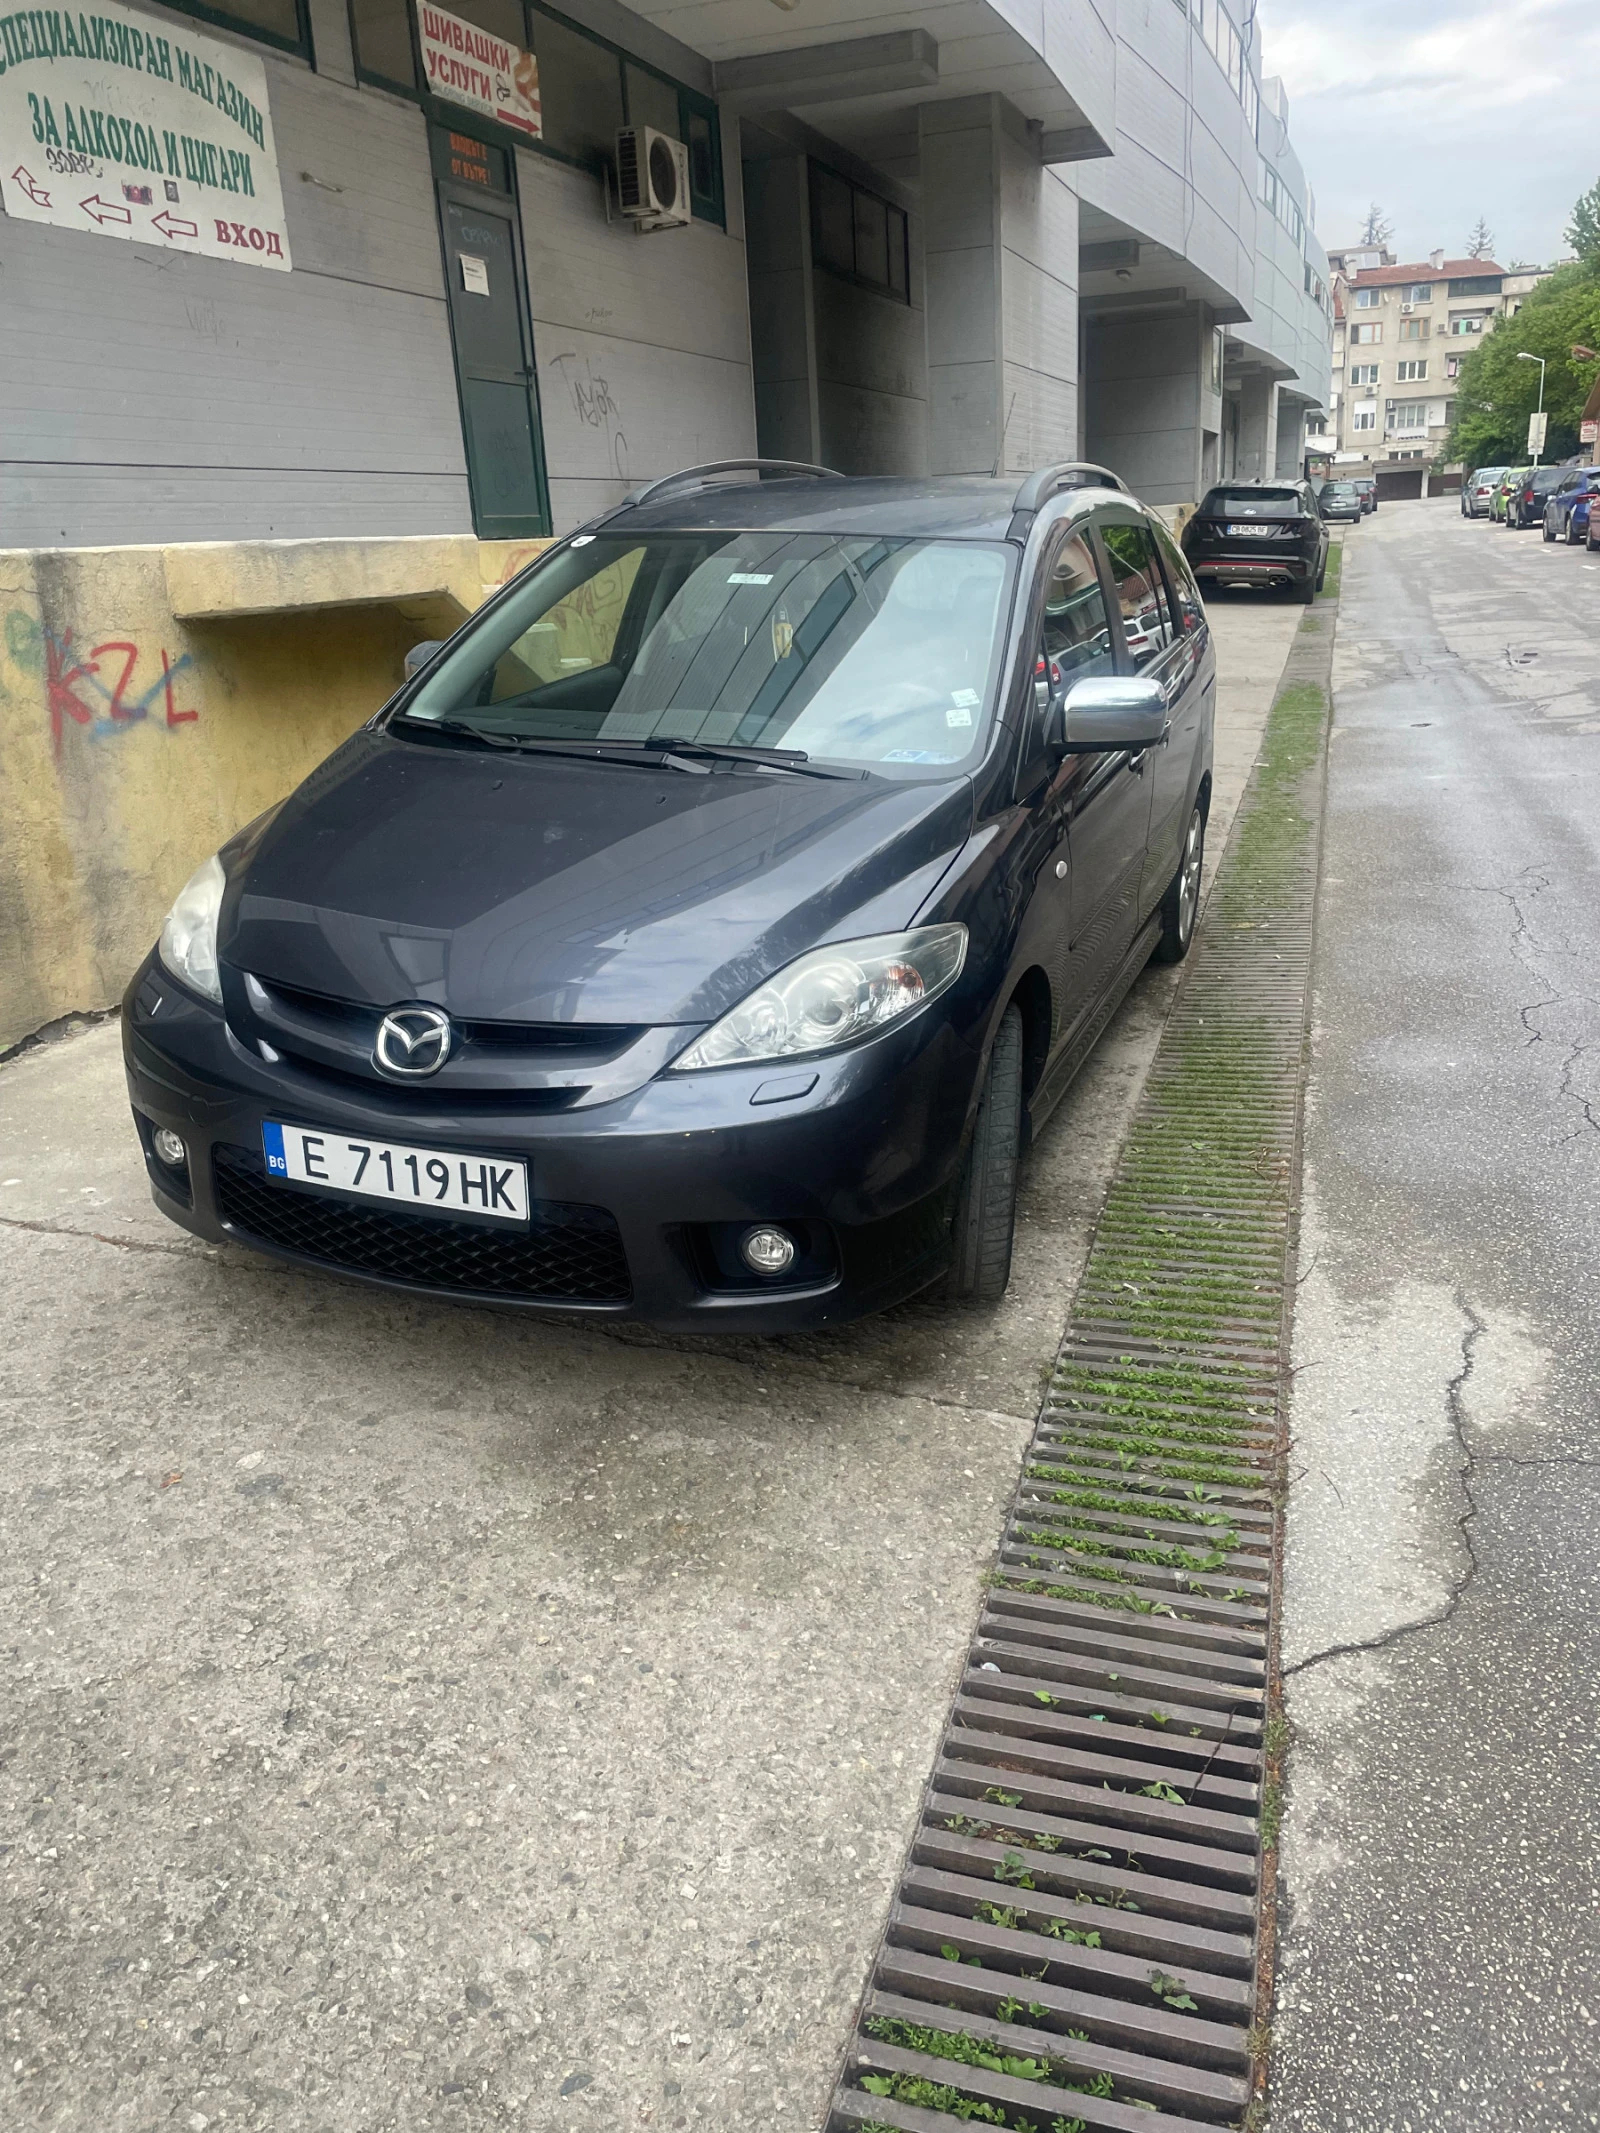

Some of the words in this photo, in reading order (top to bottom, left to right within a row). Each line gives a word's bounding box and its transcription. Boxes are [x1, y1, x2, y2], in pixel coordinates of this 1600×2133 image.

[423, 8, 511, 74] ШИВАШКИ
[175, 46, 265, 152] МАГАЗИН
[426, 48, 492, 102] УСЛУГИ
[28, 92, 62, 147] ЗА
[65, 101, 163, 174] АЛКОХОЛ
[163, 130, 181, 178] И
[181, 135, 255, 197] ЦИГАРИ
[214, 219, 283, 259] ВХОД
[269, 1155, 285, 1170] BG
[302, 1135, 329, 1180] E
